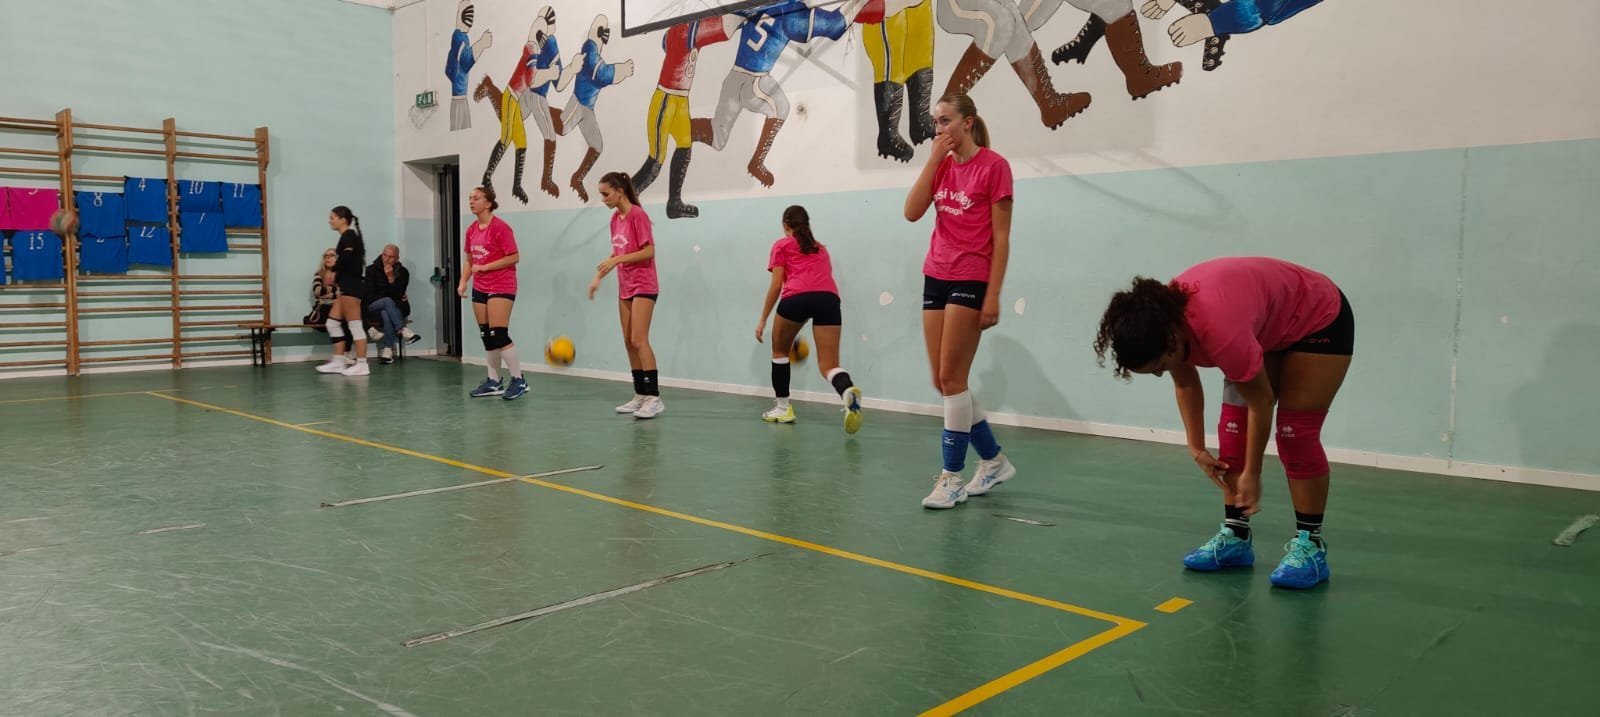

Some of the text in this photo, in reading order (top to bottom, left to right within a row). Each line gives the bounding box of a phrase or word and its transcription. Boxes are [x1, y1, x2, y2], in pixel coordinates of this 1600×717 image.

[684, 47, 698, 79] 8
[189, 180, 204, 195] 10
[233, 183, 245, 198] 11
[93, 191, 103, 207] 8
[29, 232, 45, 250] 15
